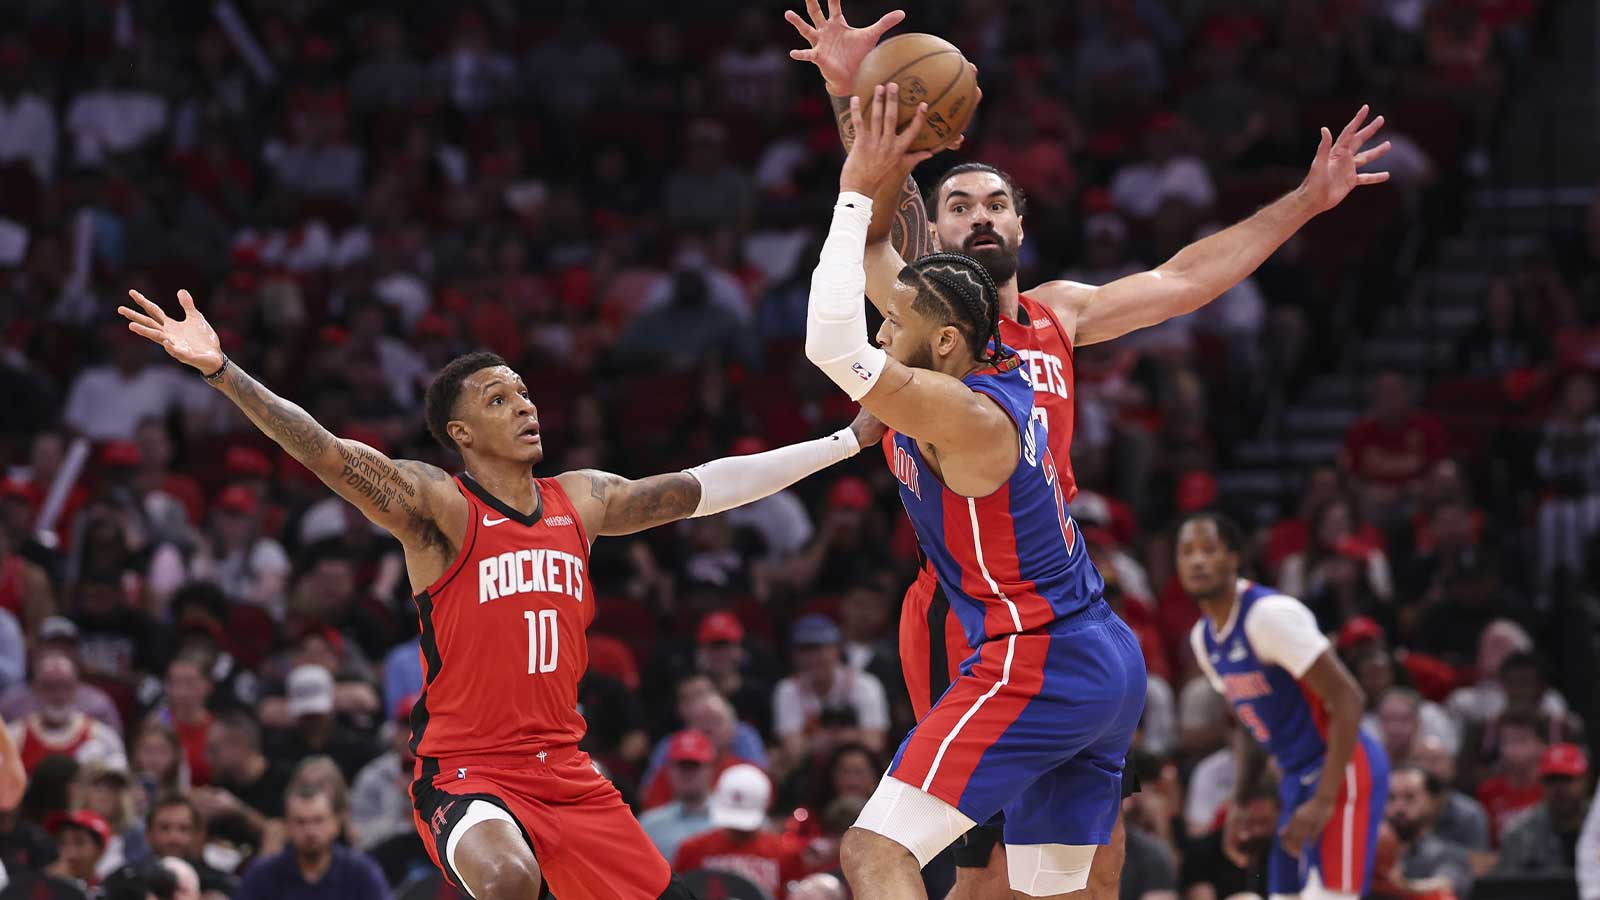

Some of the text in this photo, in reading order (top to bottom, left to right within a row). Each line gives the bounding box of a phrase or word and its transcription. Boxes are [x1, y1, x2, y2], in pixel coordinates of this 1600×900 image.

[340, 464, 391, 513] POTENTIAL
[478, 548, 584, 604] ROCKETS
[524, 608, 560, 675] 10
